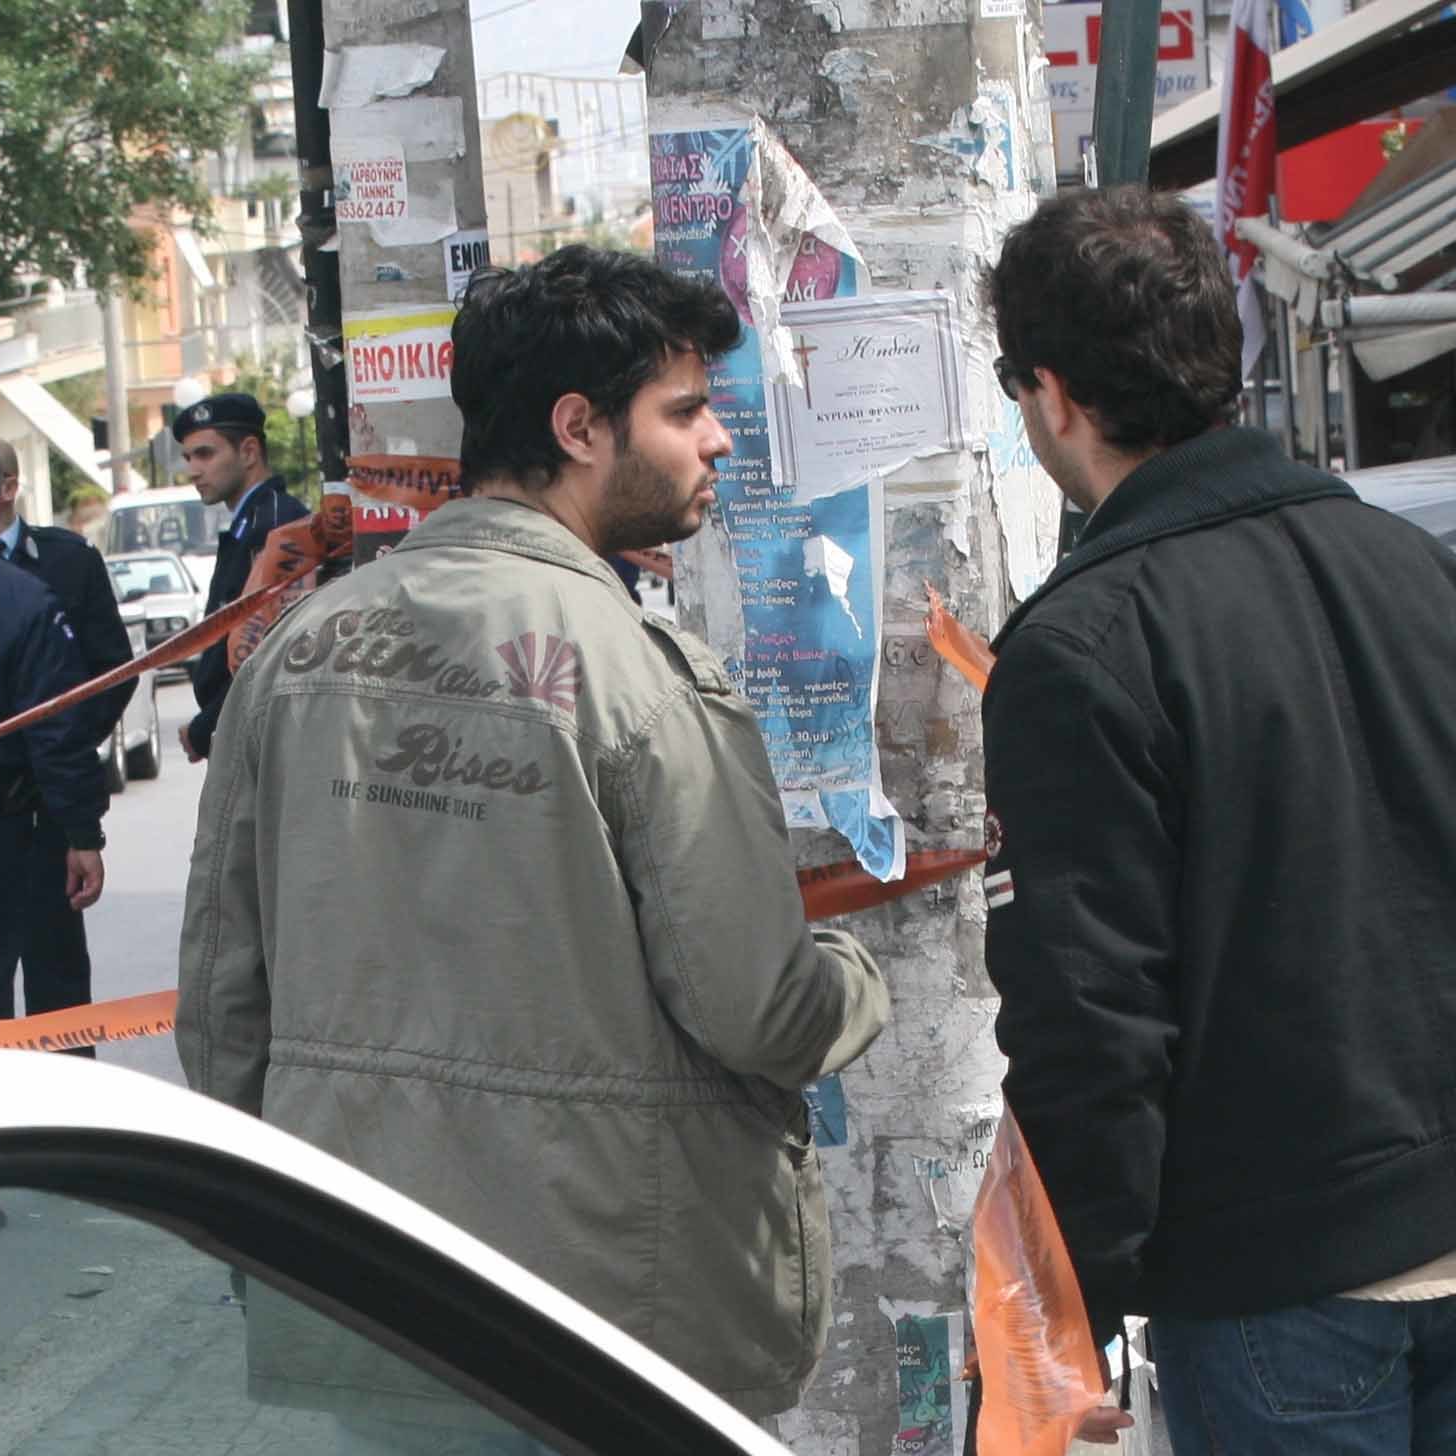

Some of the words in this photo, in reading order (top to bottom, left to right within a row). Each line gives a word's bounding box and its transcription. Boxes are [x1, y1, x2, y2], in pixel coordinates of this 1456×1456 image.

[376, 723, 553, 795] Rises
[330, 779, 361, 800] THE
[366, 783, 450, 816] SUNSHINE
